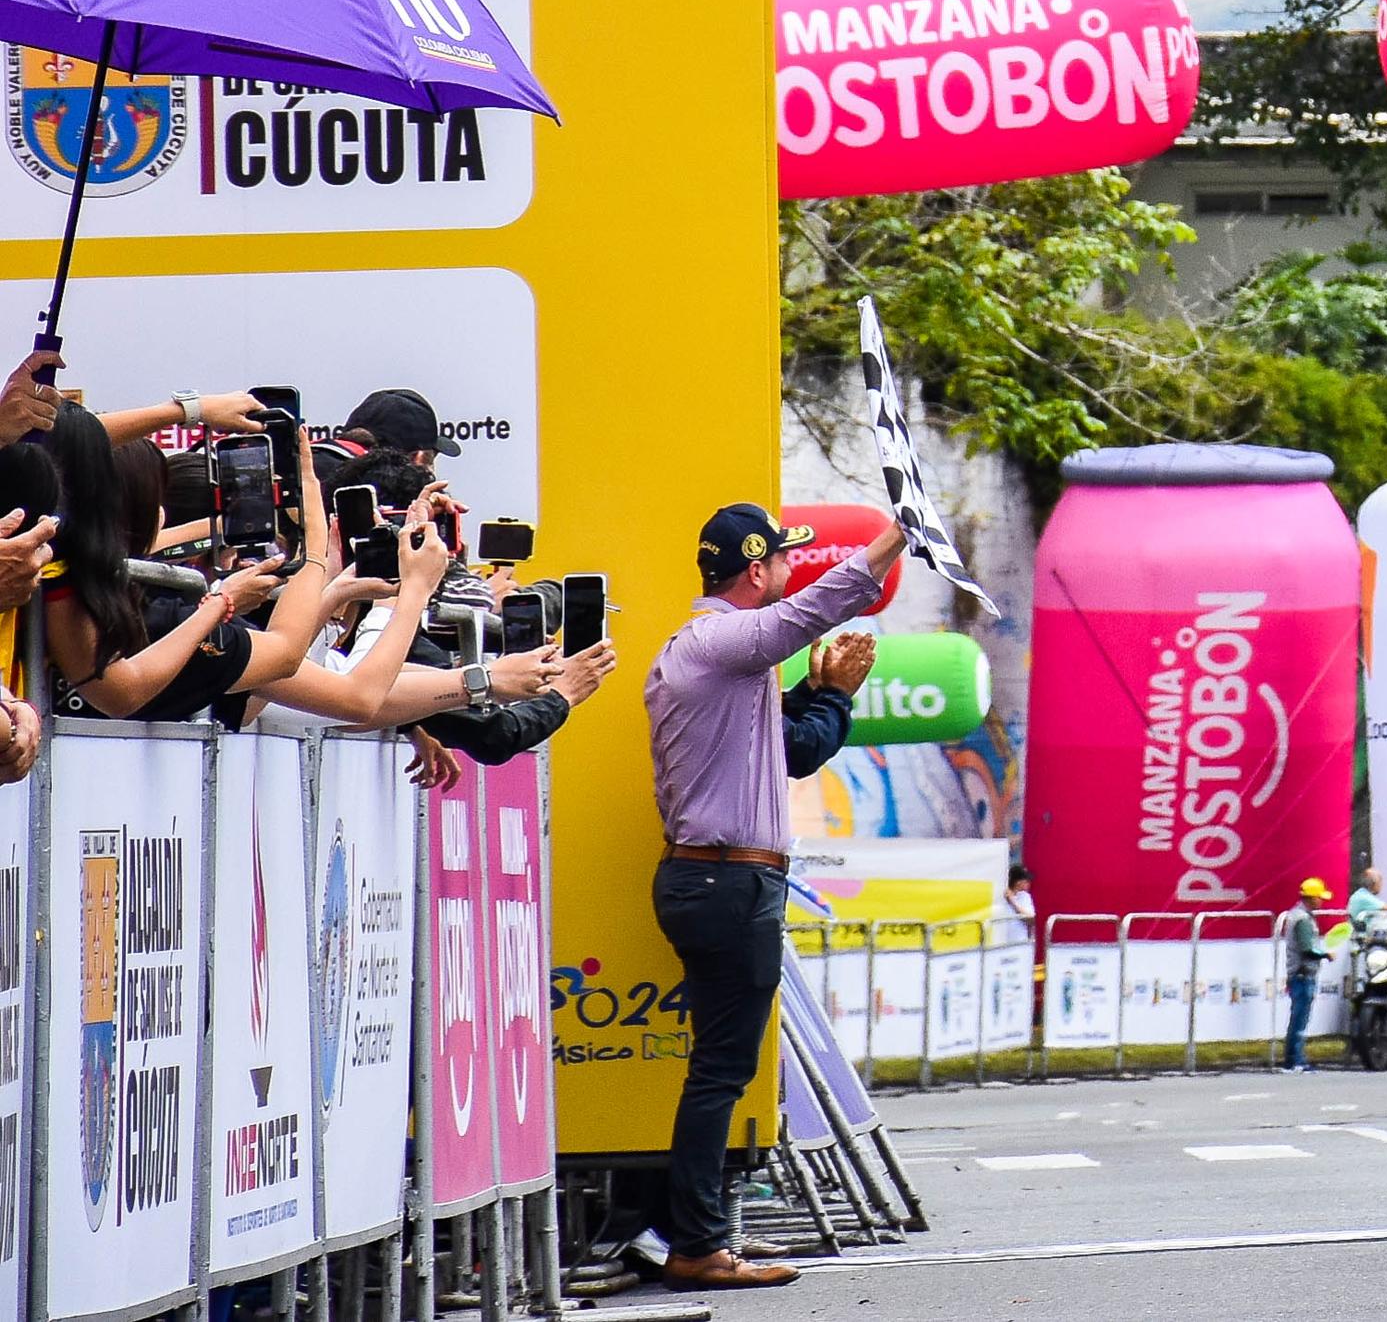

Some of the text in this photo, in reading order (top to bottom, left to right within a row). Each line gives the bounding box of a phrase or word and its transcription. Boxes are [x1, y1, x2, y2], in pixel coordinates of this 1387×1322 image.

[172, 87, 186, 108] DE
[9, 99, 26, 149] NOBLE
[21, 153, 51, 180] MUY
[225, 96, 485, 188] CÚCUTA
[439, 415, 510, 449] porte
[1139, 669, 1185, 851] MANZANA
[127, 816, 183, 955] ALCALDÍA
[127, 968, 138, 1041] DE
[551, 1035, 634, 1066] ásico
[125, 1043, 180, 1213] CÚCUTA
[225, 1114, 299, 1197] INDENORTE
